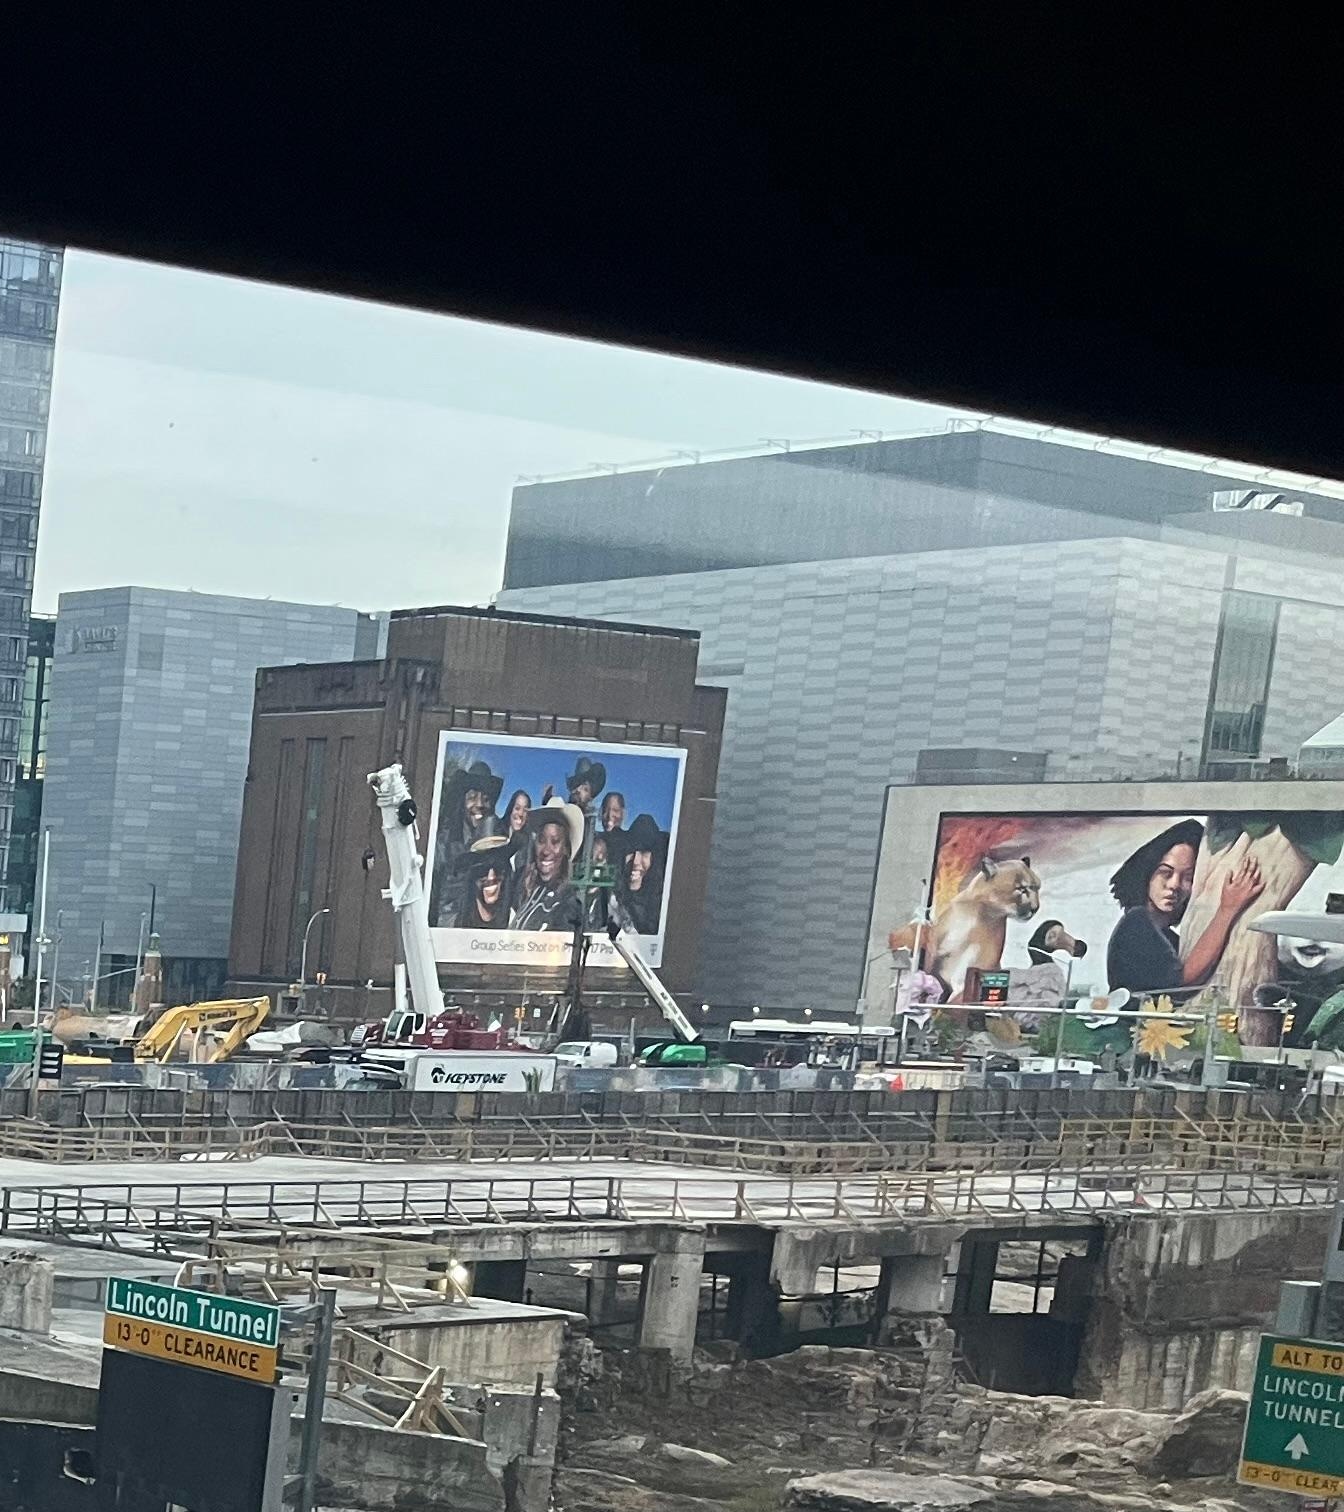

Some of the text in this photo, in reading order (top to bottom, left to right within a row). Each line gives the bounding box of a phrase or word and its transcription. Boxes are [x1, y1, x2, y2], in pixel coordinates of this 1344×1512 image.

[444, 1073, 508, 1084] KEYSTONE
[111, 1281, 273, 1341] Lincoln Tunnel
[164, 1333, 261, 1372] CLEARANCE
[1280, 1349, 1343, 1371] ALT TO
[1263, 1400, 1344, 1429] TUNNEL
